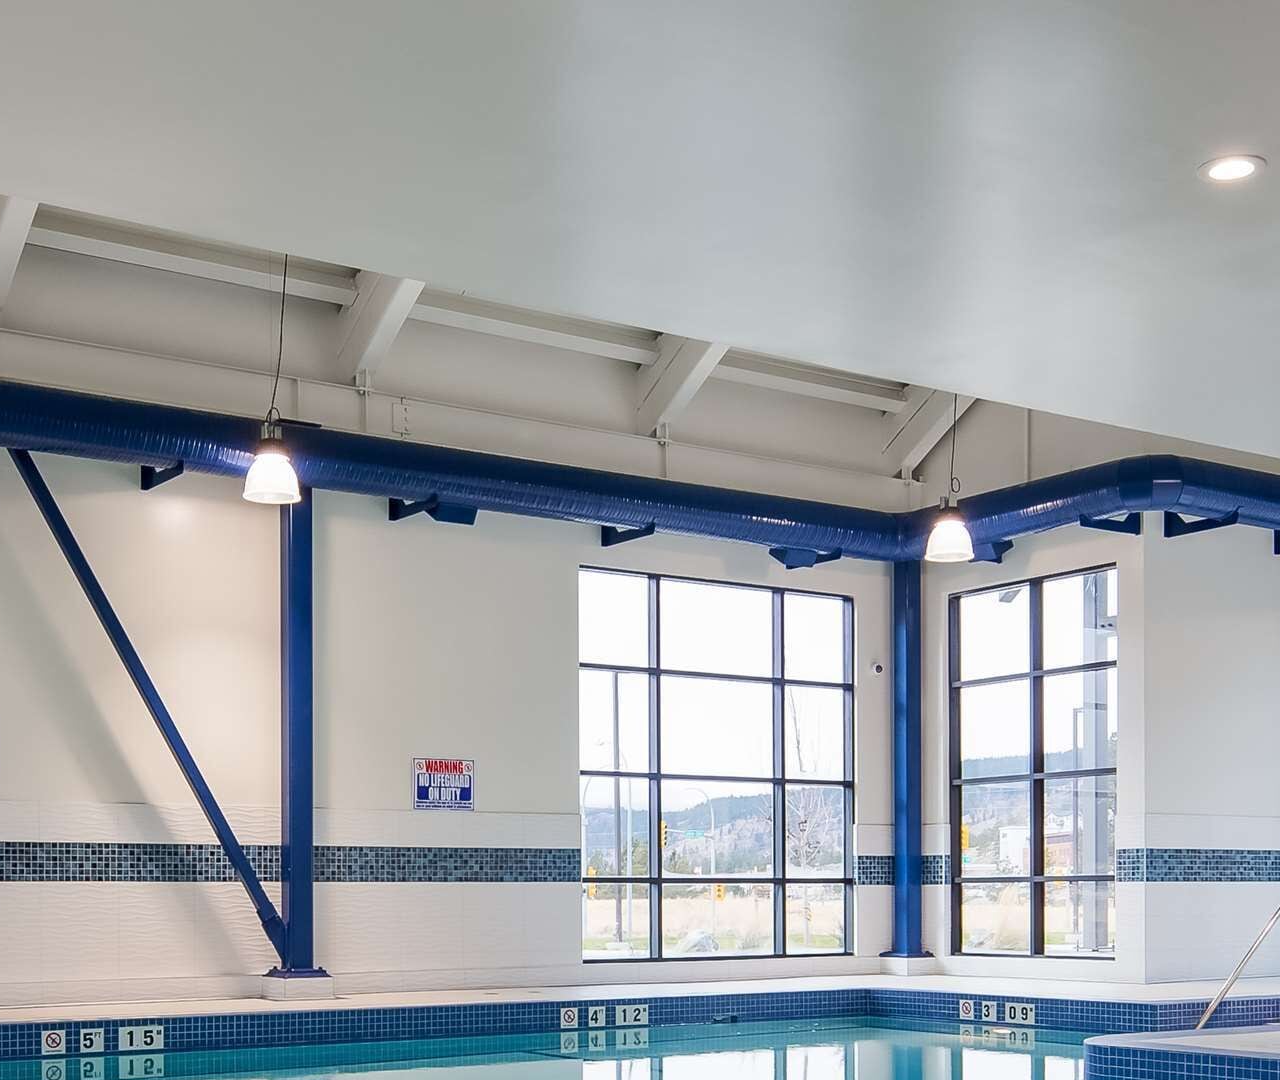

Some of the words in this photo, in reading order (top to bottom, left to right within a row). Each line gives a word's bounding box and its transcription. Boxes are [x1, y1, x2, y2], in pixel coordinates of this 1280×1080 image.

[425, 760, 464, 774] WARNING
[419, 774, 429, 787] NO
[431, 774, 470, 788] LIFEGUARD
[428, 787, 439, 800] ON
[441, 788, 461, 801] DUTY
